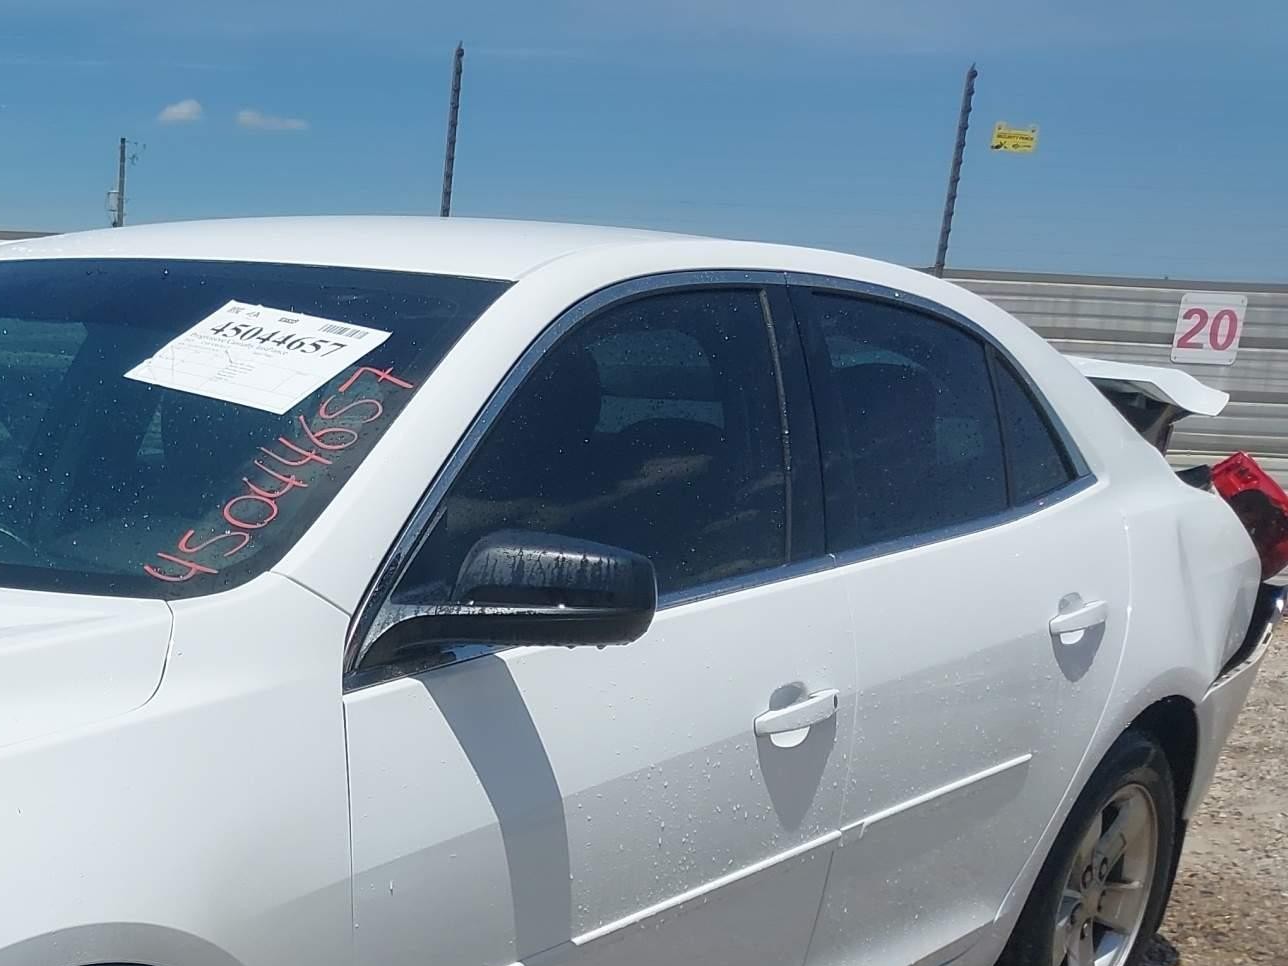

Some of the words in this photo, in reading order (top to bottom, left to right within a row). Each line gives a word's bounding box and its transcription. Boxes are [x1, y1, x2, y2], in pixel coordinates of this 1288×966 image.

[210, 321, 349, 358] 45044657
[1177, 307, 1239, 351] 20
[143, 366, 414, 583] 45044657
